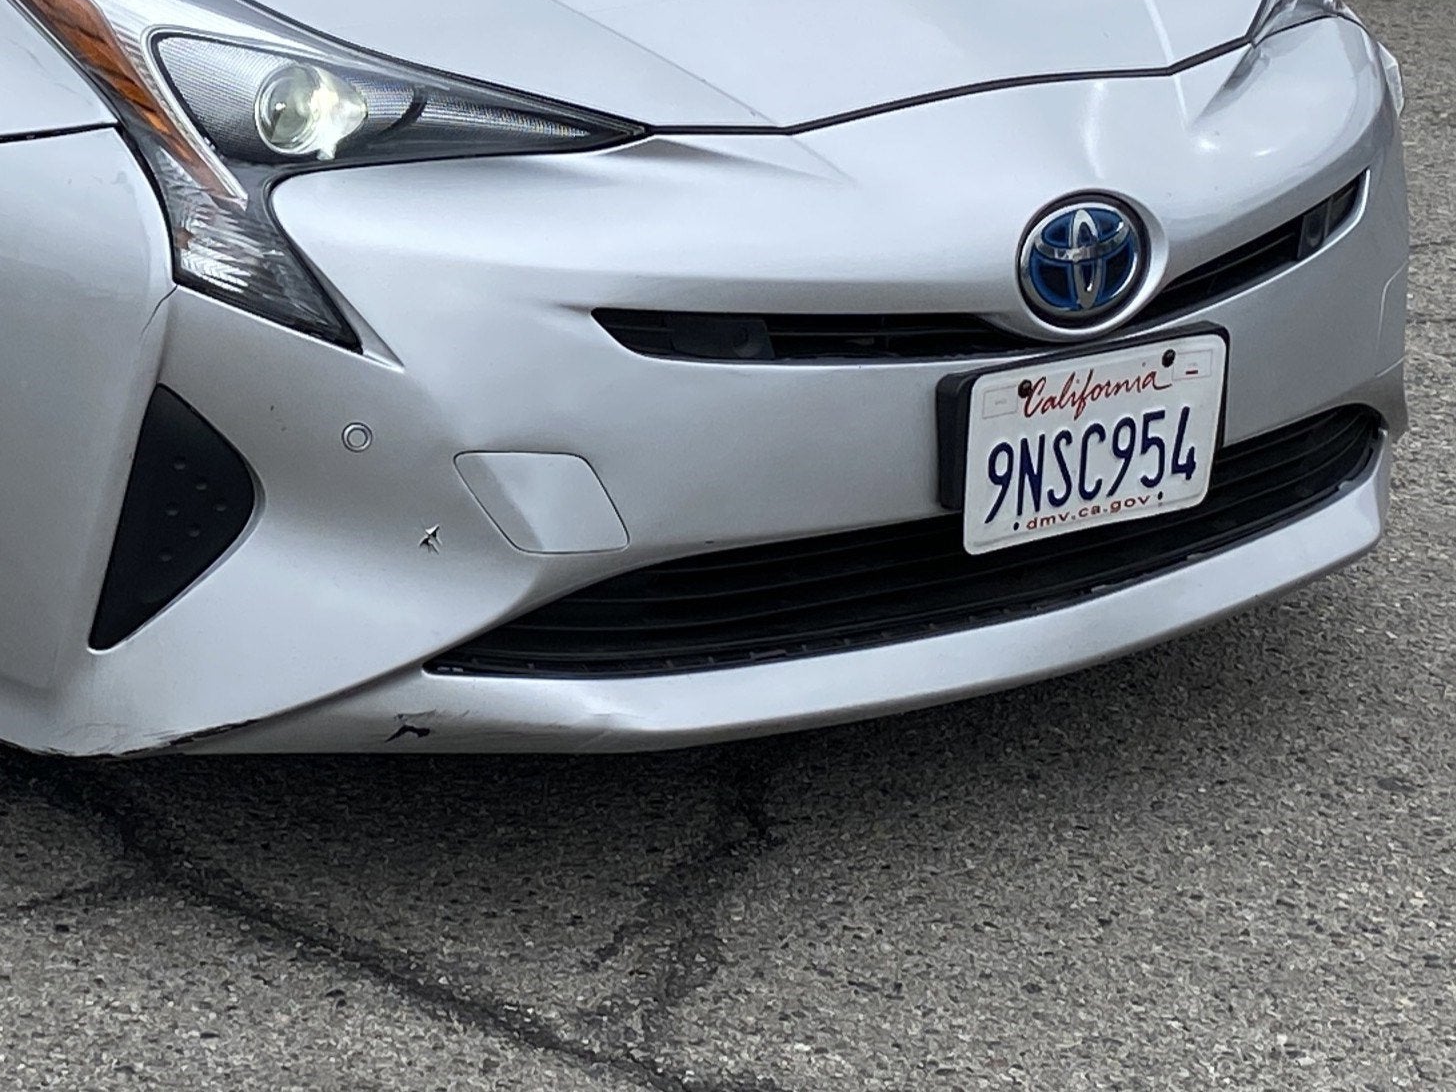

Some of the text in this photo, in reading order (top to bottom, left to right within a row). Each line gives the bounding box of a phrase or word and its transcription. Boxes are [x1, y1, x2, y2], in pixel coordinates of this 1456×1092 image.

[1022, 369, 1172, 420] California
[985, 406, 1196, 523] 9NSC954
[1026, 494, 1151, 530] dmv.ca.gov
